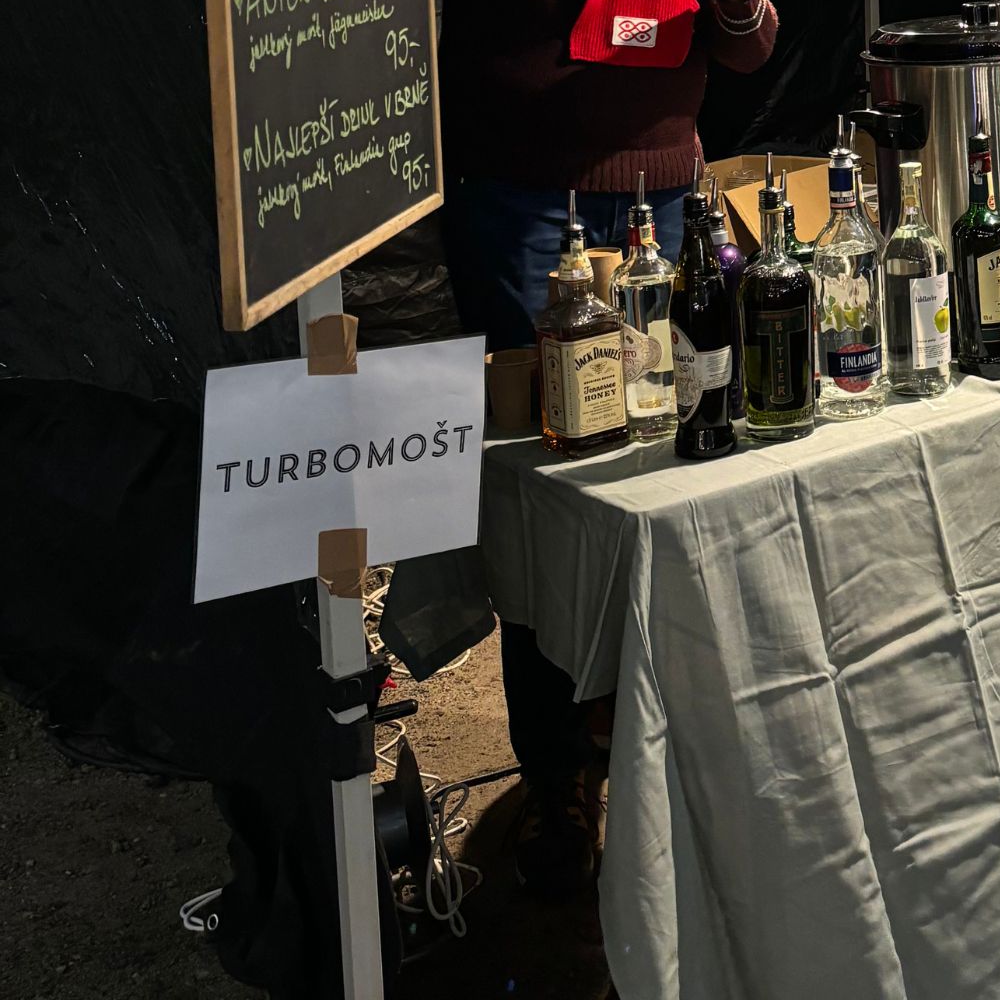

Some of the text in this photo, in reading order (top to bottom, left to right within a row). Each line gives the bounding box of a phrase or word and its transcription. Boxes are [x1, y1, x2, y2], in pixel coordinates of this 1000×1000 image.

[250, 24, 292, 73] jablkový
[253, 62, 430, 173] NAJLEPŠÍ DRINK V BRNĚ
[256, 172, 300, 229] jablkový
[574, 346, 622, 371] JACK DANIEL'S
[774, 320, 786, 397] BITTER
[840, 351, 878, 369] FINLANDIA
[583, 381, 617, 395] Tennessee
[584, 388, 617, 403] HONEY
[216, 420, 473, 493] TURBOMOŠT
